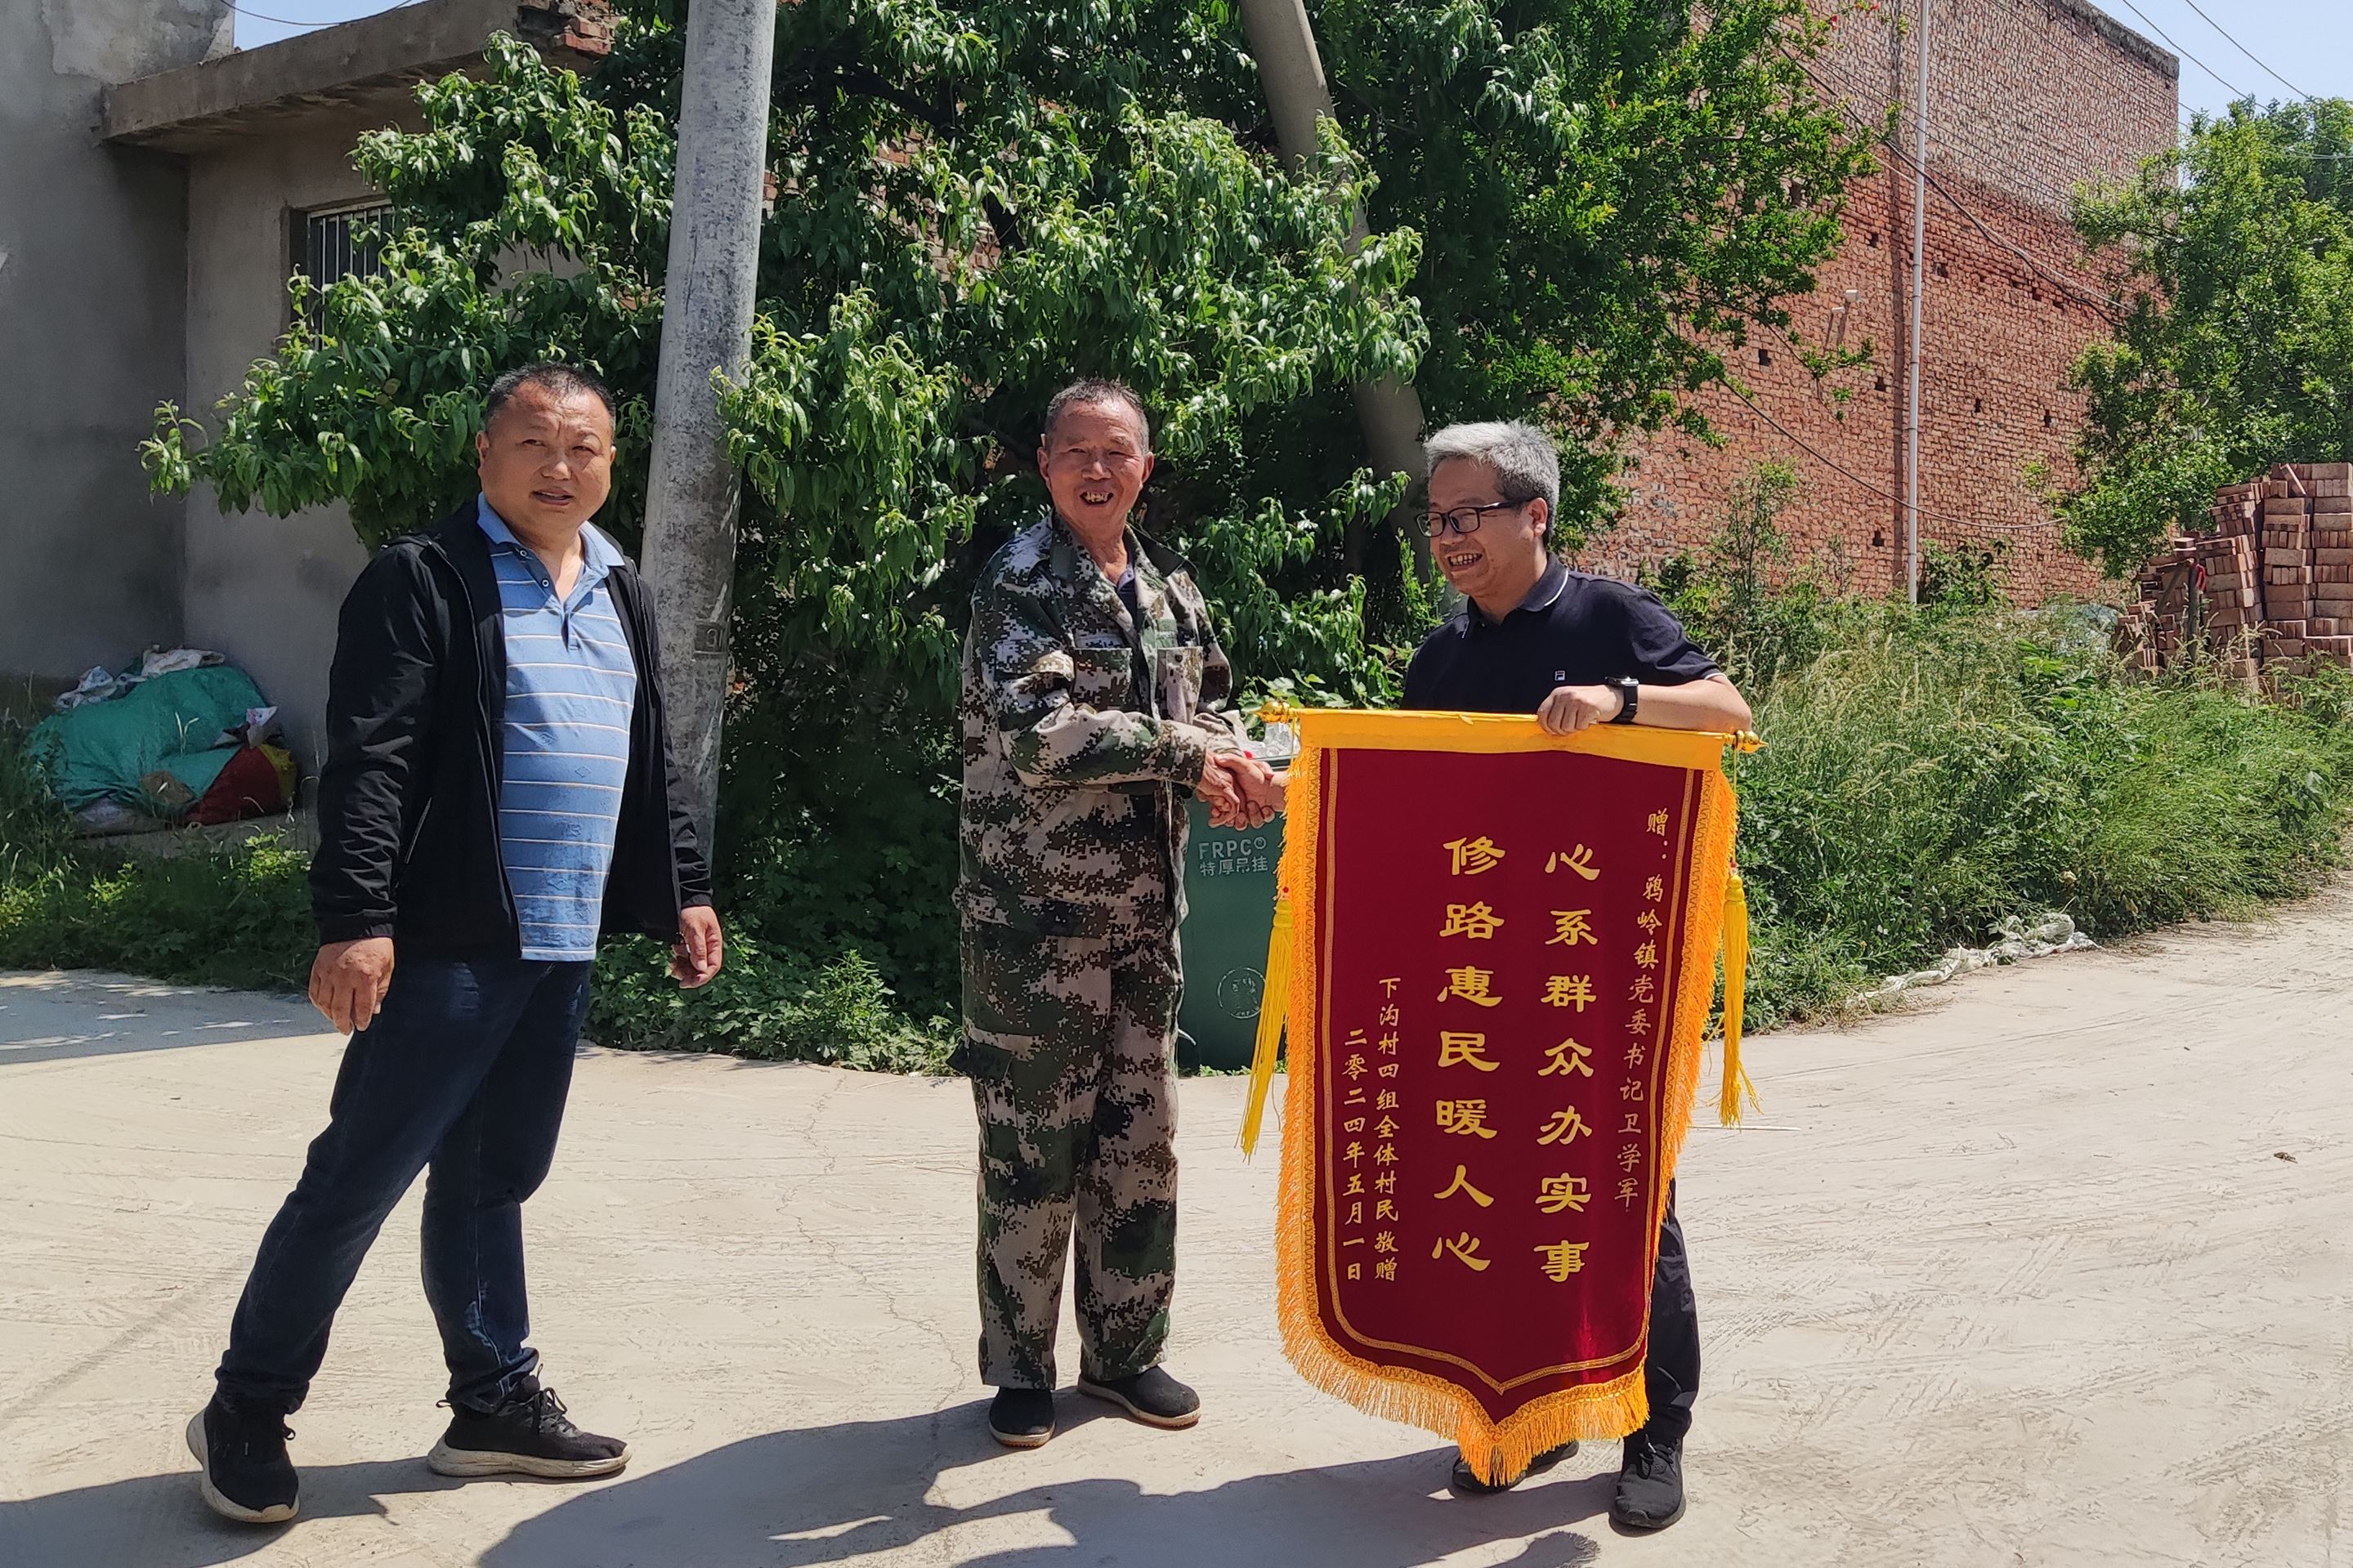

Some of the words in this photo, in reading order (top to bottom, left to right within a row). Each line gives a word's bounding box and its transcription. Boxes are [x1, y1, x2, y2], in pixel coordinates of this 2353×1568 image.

[1198, 839, 1252, 860] FRPC
[1341, 1028, 1368, 1281] 二零二四年五月一日
[1373, 977, 1401, 1282] 下沟村四组全体村民敬赠
[1432, 837, 1505, 1271] 修路惠民暖人心
[1533, 843, 1600, 1283] 心系群众办实事
